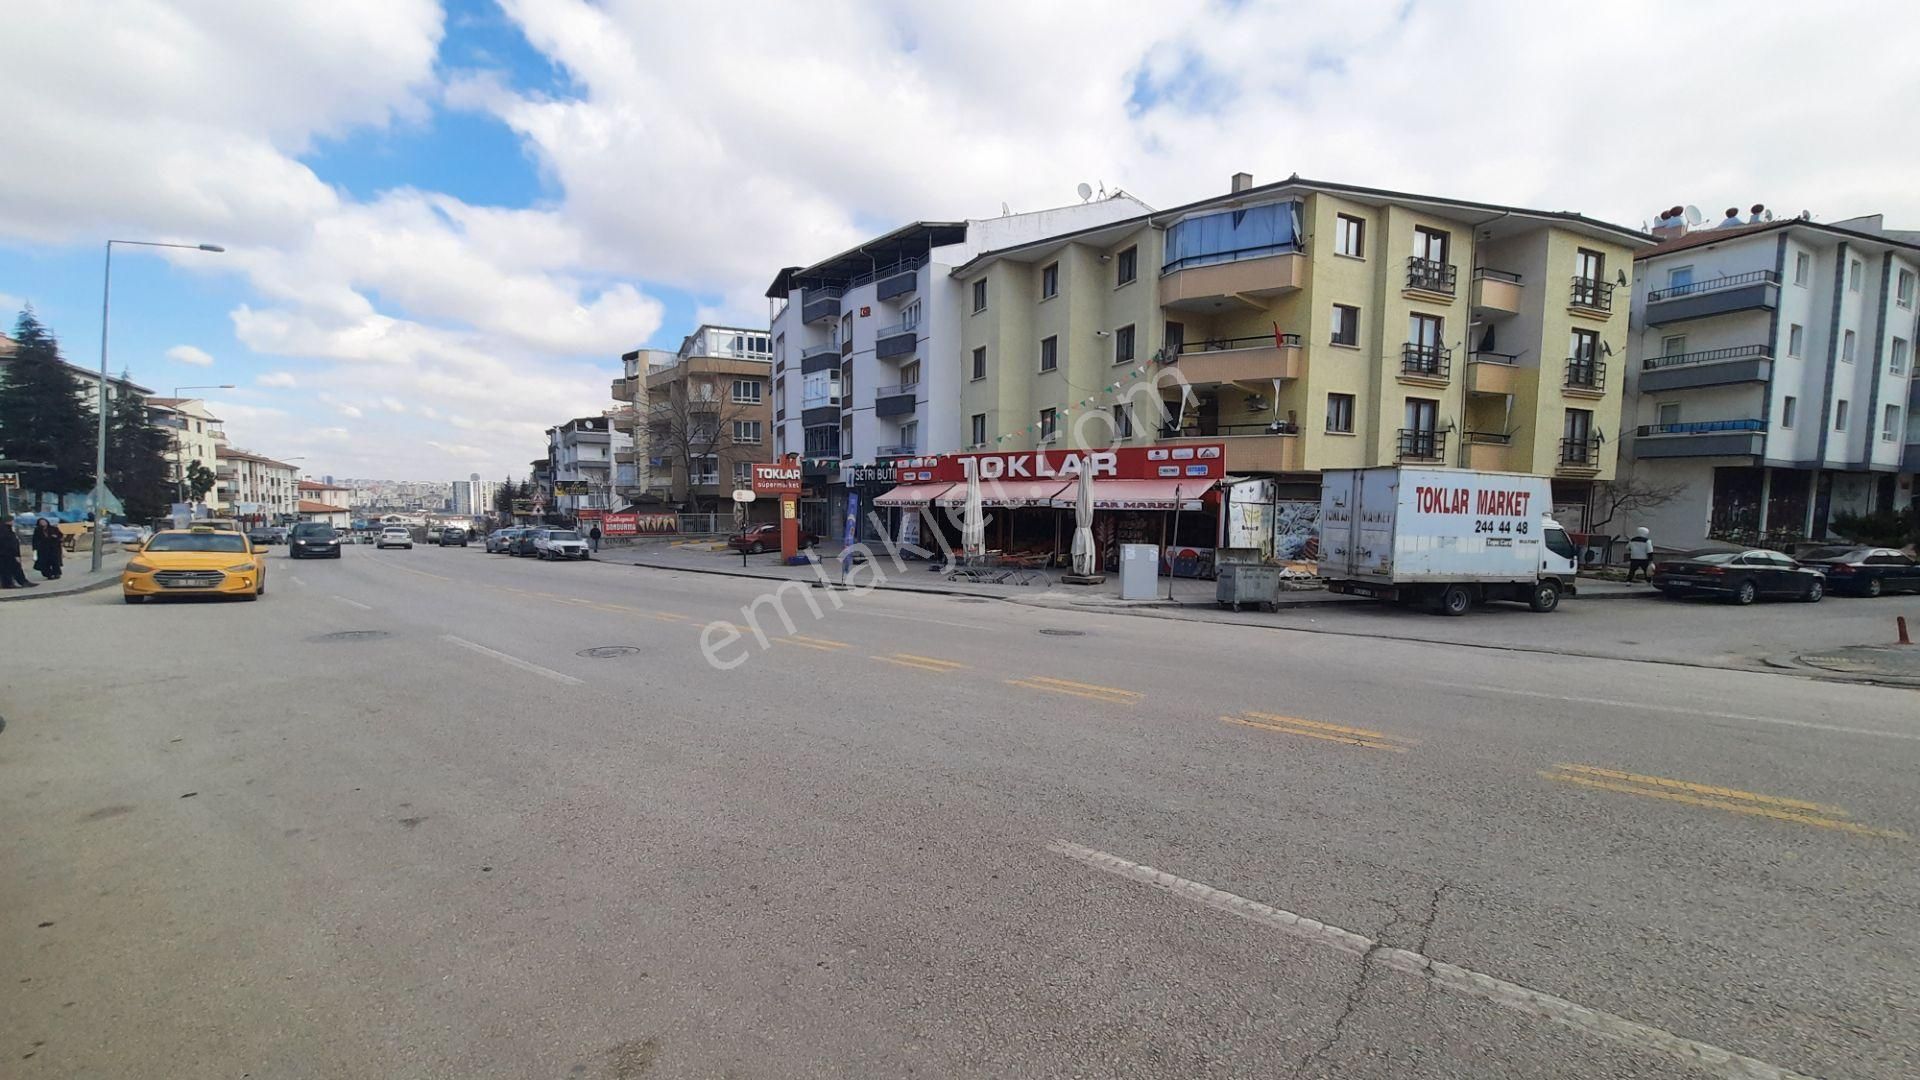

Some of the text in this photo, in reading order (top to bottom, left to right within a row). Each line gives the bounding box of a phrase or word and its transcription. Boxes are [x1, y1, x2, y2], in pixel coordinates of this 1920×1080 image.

[757, 468, 800, 479] TOKLAR
[958, 453, 1117, 479] TOKLAR
[1416, 487, 1530, 517] TOKLAR MARKET
[1474, 519, 1529, 535] 244 44 48
